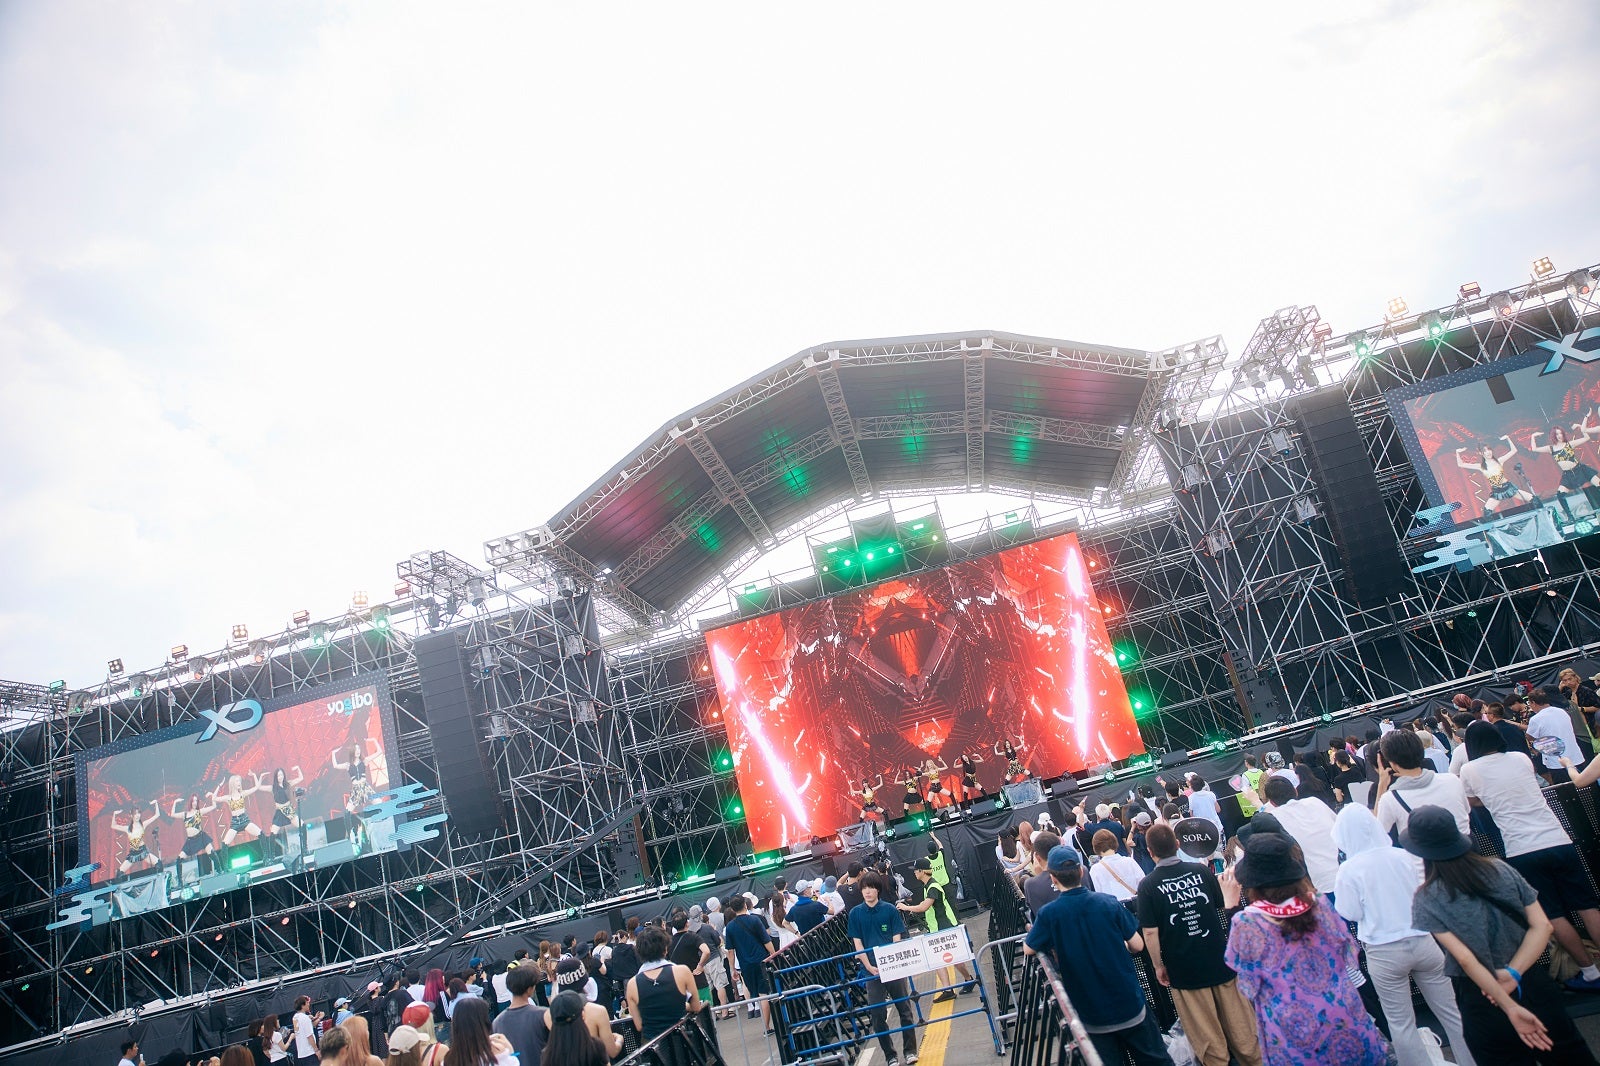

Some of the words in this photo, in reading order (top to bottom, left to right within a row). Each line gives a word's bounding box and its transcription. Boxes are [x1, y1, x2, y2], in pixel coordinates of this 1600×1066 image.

[327, 692, 373, 716] yogibo
[1182, 833, 1212, 843] SORA
[1157, 874, 1204, 894] WOOAH
[1167, 887, 1201, 904] LAND
[928, 933, 958, 947] 関係者以外
[933, 942, 958, 954] 立入禁止
[879, 948, 920, 965] 立ち見禁止
